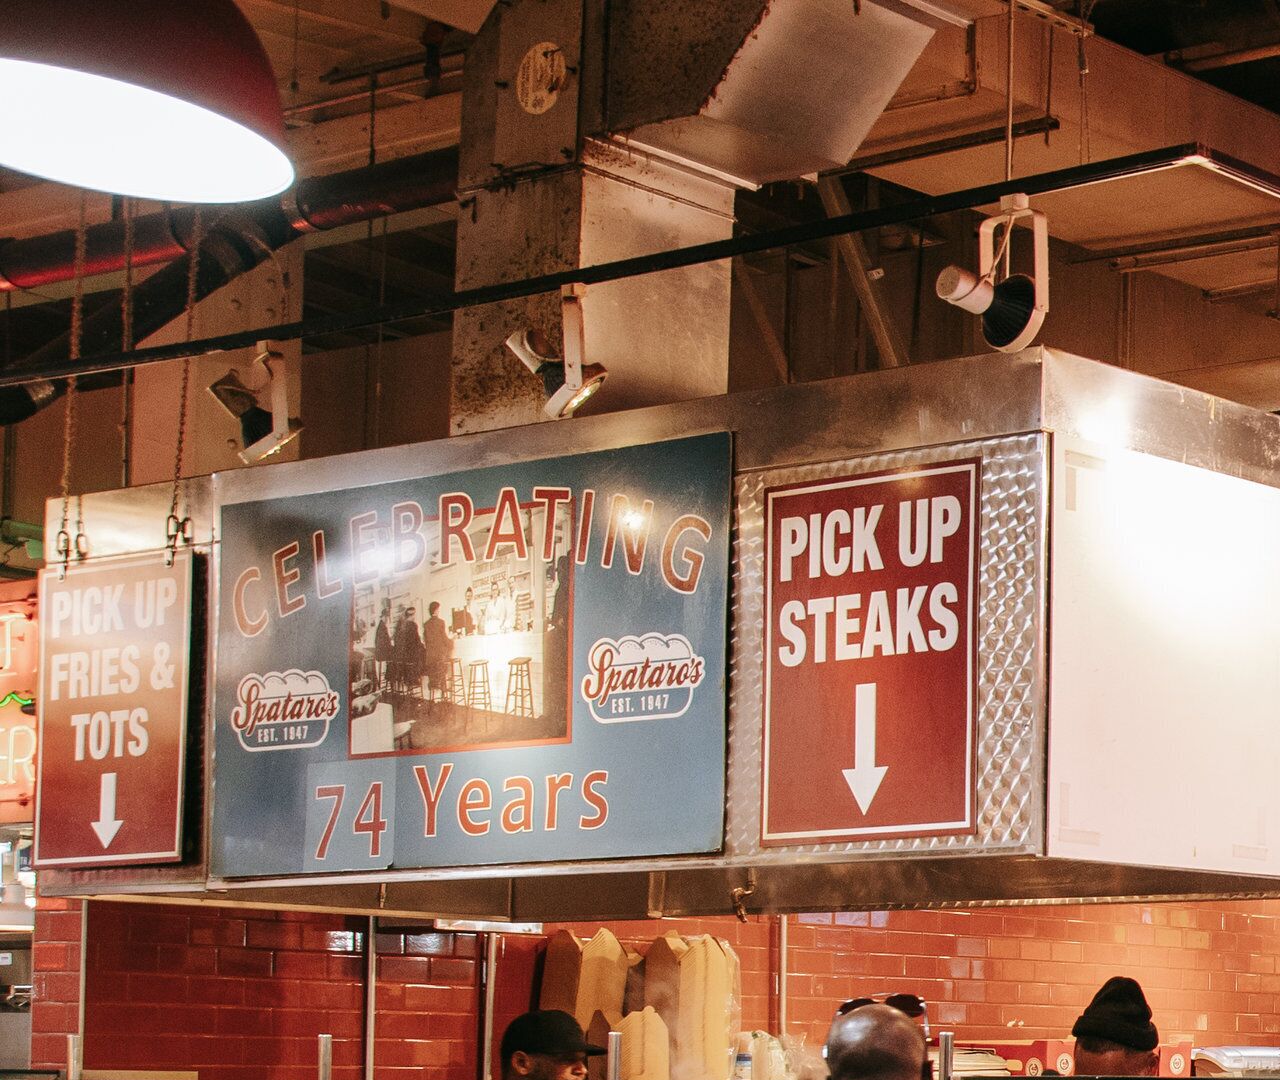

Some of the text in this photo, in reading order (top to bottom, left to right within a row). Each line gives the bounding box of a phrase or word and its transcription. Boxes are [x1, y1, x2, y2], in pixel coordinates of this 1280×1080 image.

[232, 487, 713, 638] CELEBRATING
[779, 495, 962, 582] PICK UP
[51, 577, 179, 638] PICK UP
[778, 581, 960, 668] STEAKS
[50, 641, 176, 701] FRIES &
[584, 648, 703, 706] Spataro's
[234, 683, 337, 736] Spataro's
[257, 725, 309, 742] EST. 1947
[611, 694, 670, 714] EST. 1947
[71, 710, 149, 762] TOTS
[314, 762, 612, 862] 74 Years
